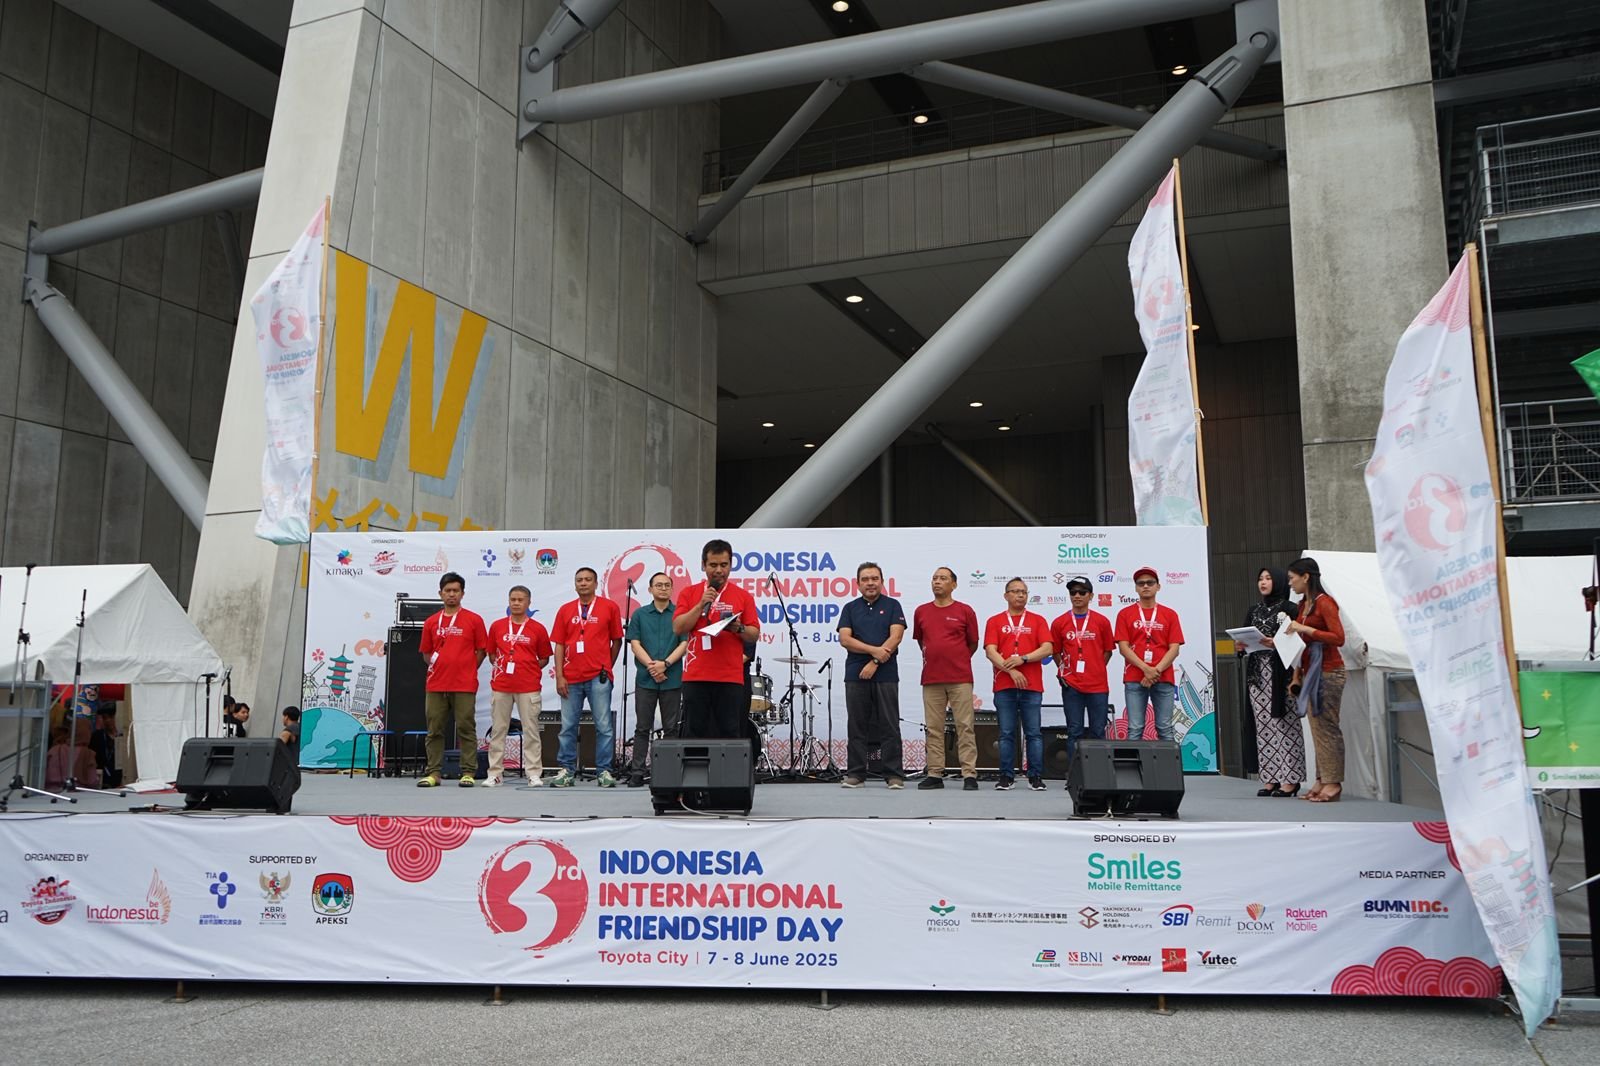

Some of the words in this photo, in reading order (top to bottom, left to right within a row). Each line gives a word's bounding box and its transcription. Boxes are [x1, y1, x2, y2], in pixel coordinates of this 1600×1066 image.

[336, 250, 488, 480] W
[1057, 543, 1109, 559] Smiles
[702, 552, 837, 572] DONESIA
[1098, 575, 1114, 583] SBI
[1093, 834, 1161, 844] SPONSORED
[1162, 834, 1177, 844] BY
[24, 853, 75, 862] ORGANIZED
[76, 853, 89, 862] BY
[249, 855, 303, 864] SUPPORTED
[305, 856, 318, 865] BY
[599, 850, 764, 876] INDONESIA
[1087, 852, 1182, 880] Smiles
[1359, 870, 1394, 879] MEDIA
[1395, 871, 1447, 879] PARTNER
[1087, 881, 1122, 891] Mobile
[1124, 882, 1182, 891] Remittance
[598, 882, 843, 910] INTERNATIONAL
[149, 900, 159, 908] be
[86, 905, 160, 920] Indonesia
[1285, 908, 1328, 919] Rakuten
[315, 917, 348, 925] APEKSI
[1162, 912, 1189, 927] SBI
[1195, 915, 1232, 927] Remit
[598, 915, 768, 942] FRIENDSHIP
[777, 916, 844, 942] DAY
[1285, 922, 1318, 931] Mobile
[598, 950, 652, 965] Toyota
[656, 951, 689, 967] City
[707, 952, 717, 965] 7
[734, 952, 744, 965] 8
[749, 952, 790, 967] June
[795, 952, 838, 967] 2025
[1080, 951, 1103, 962] BNI
[1196, 950, 1237, 965] Yutec
